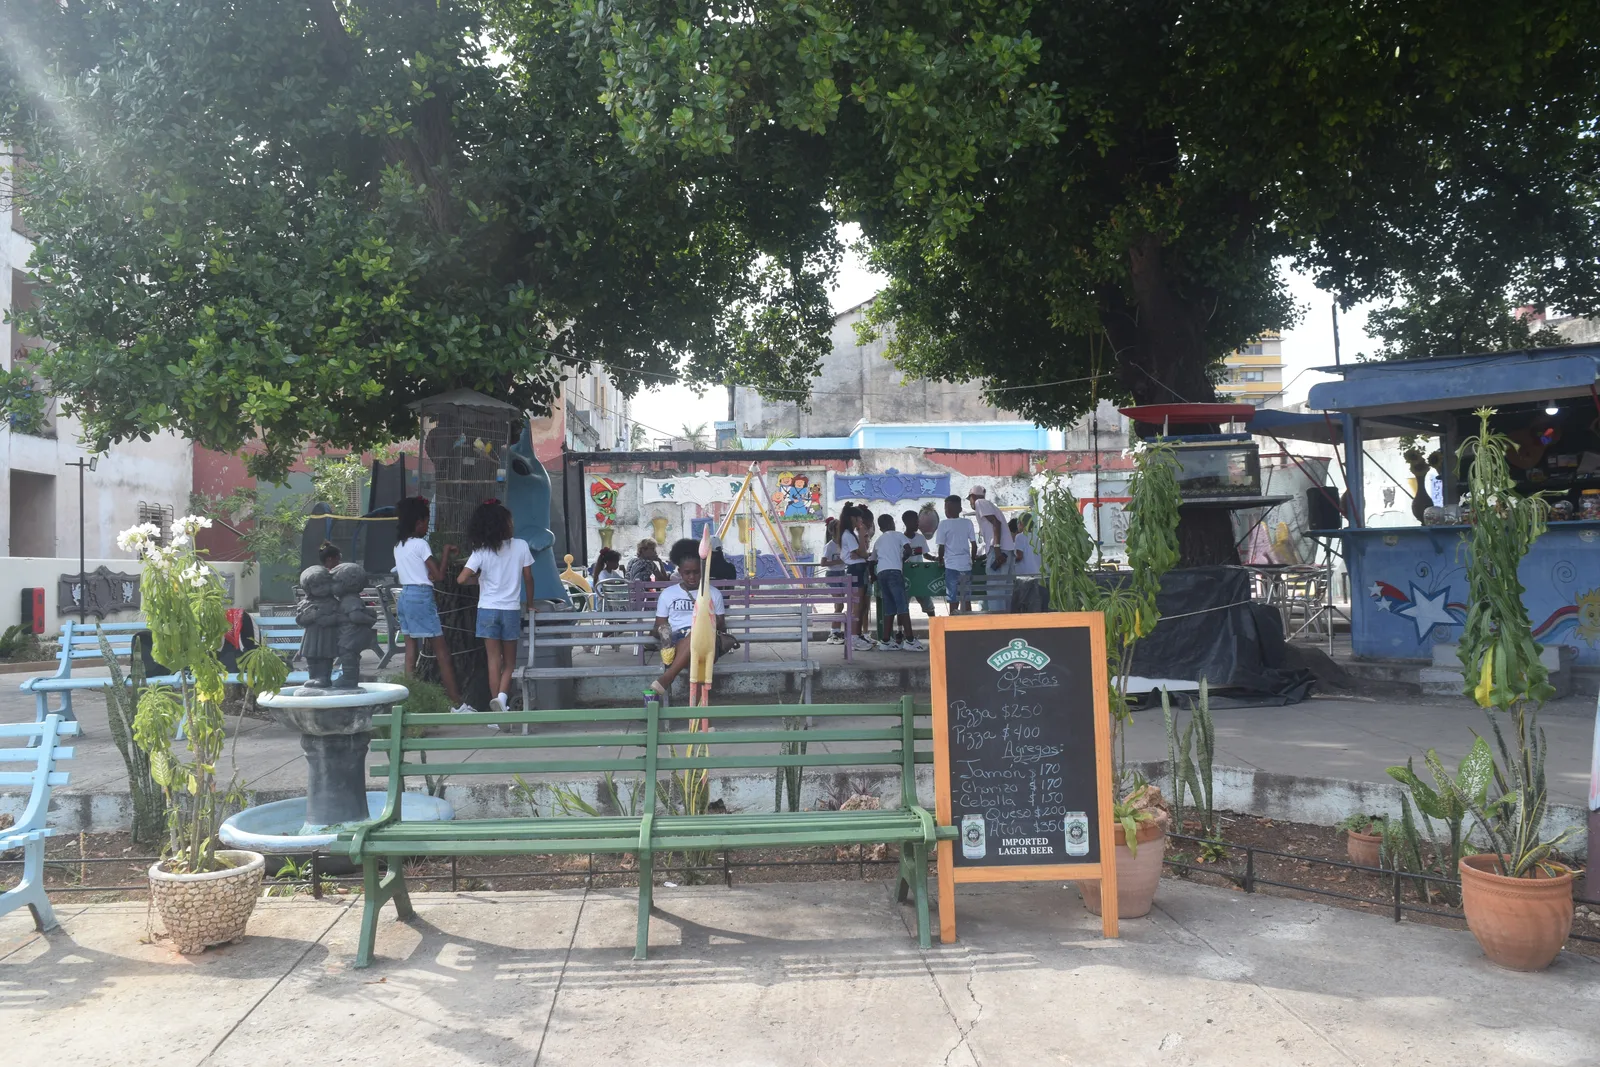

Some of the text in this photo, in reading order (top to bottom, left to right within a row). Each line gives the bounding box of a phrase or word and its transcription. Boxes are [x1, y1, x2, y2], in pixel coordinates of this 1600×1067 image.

[1014, 641, 1023, 649] 3
[993, 649, 1044, 666] HORSES
[950, 700, 1042, 728] Pizza $250
[952, 725, 996, 750] Pizza
[960, 794, 1016, 807] Cebolla
[986, 808, 1031, 820] Queso
[990, 820, 1027, 837] Atún
[1002, 837, 1049, 846] IMPORTED
[998, 846, 1054, 856] LAGER BEER
